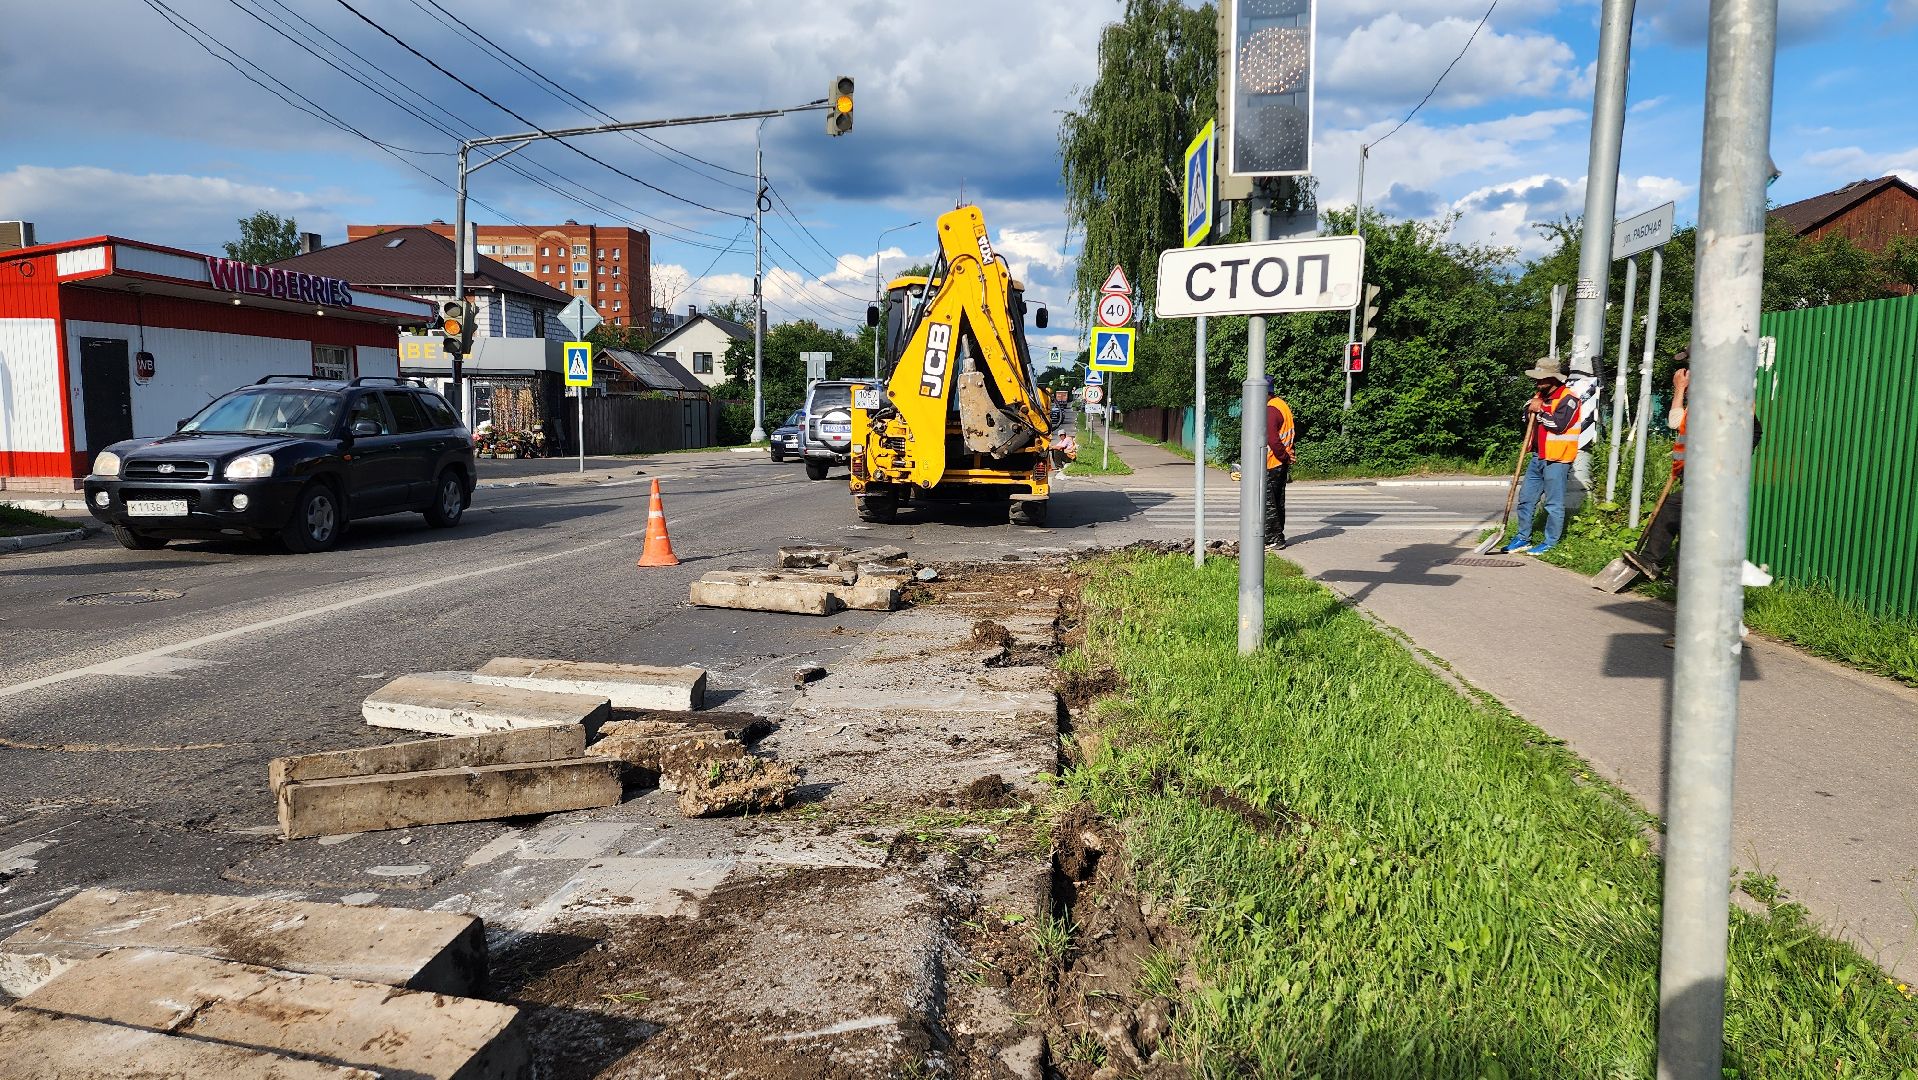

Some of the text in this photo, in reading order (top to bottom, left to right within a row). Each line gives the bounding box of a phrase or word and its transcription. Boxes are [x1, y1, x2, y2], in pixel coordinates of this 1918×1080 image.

[1632, 219, 1662, 240] РАБОЧАЯ
[205, 256, 353, 308] WILDBERRIES
[1185, 253, 1330, 302] СТОП
[1106, 304, 1125, 317] 40
[137, 360, 154, 370] WB
[922, 324, 950, 397] JCB
[1088, 390, 1099, 398] 20
